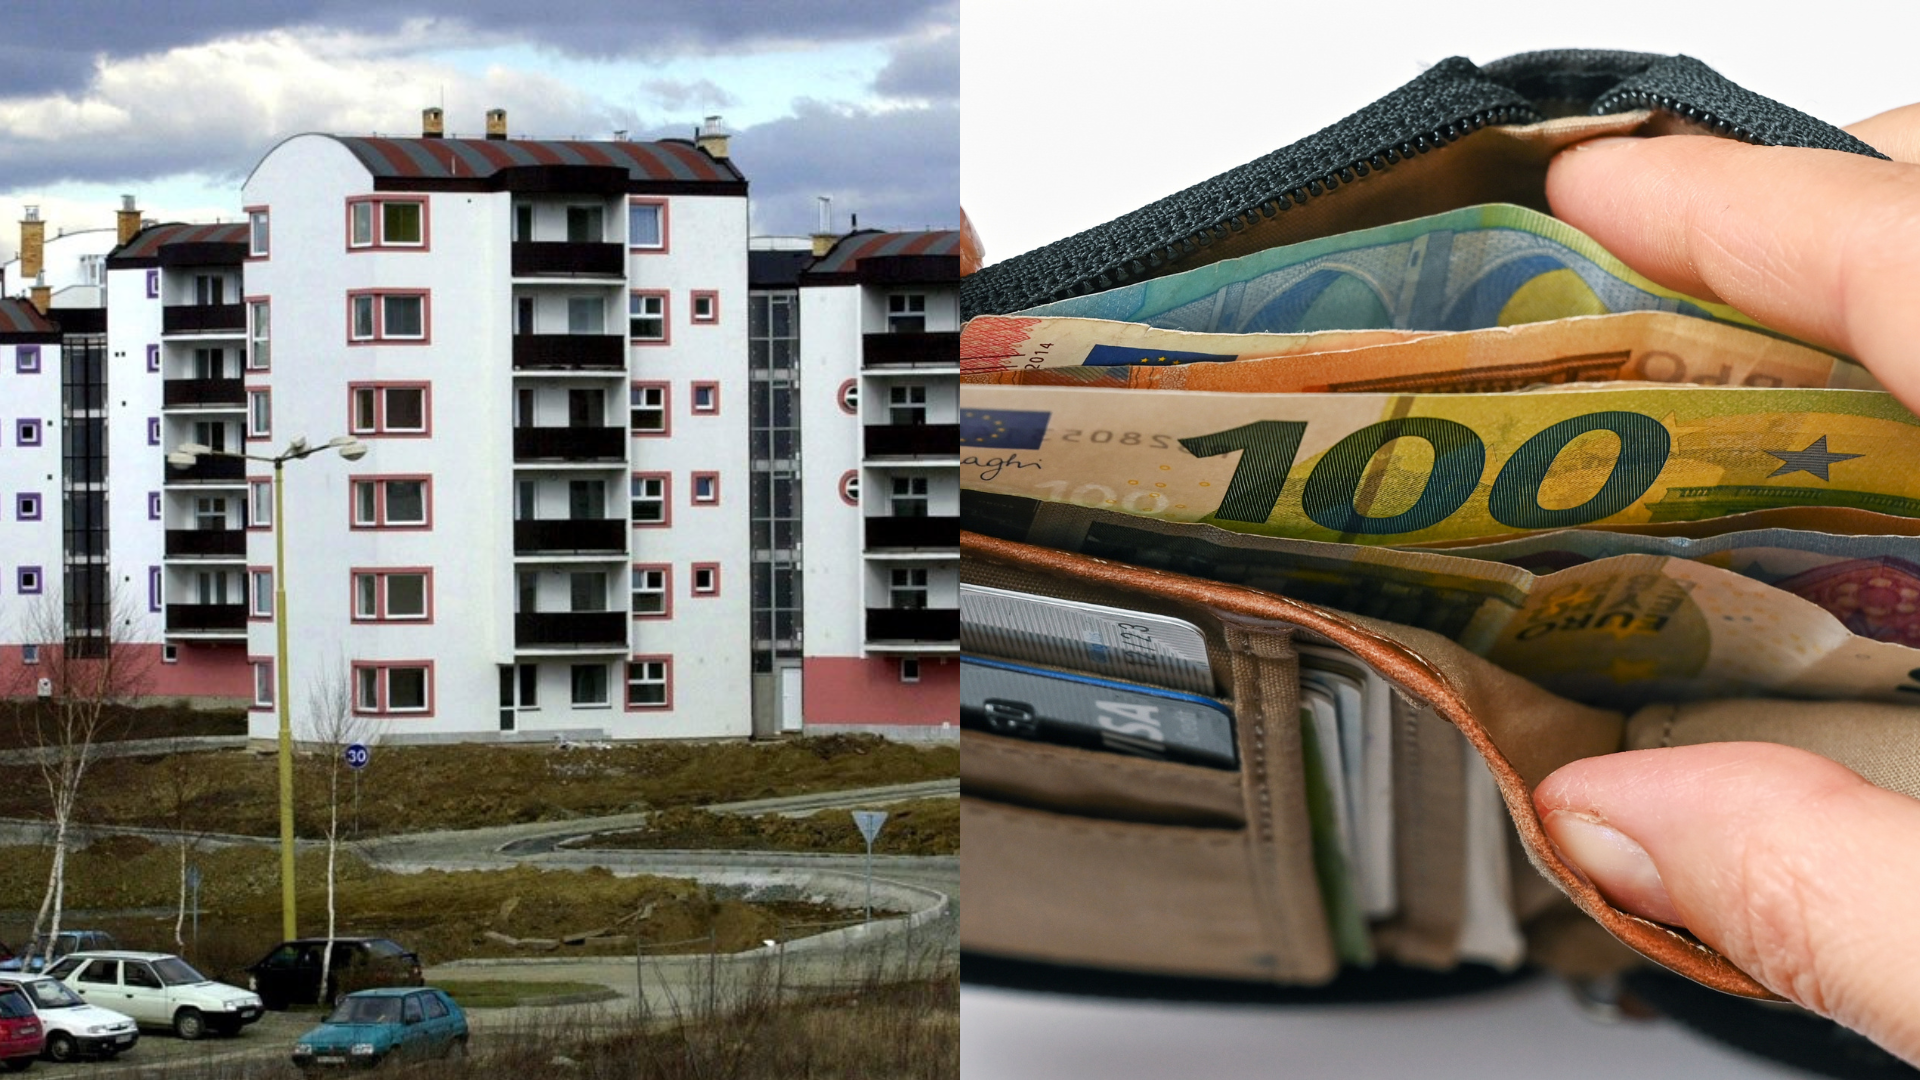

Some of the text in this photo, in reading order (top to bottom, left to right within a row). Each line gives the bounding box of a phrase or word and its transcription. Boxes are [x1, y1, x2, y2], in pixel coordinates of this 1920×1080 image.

[1024, 342, 1055, 369] 2014
[1178, 410, 1671, 535] 100
[1516, 611, 1670, 641] EURO
[348, 749, 366, 762] 30
